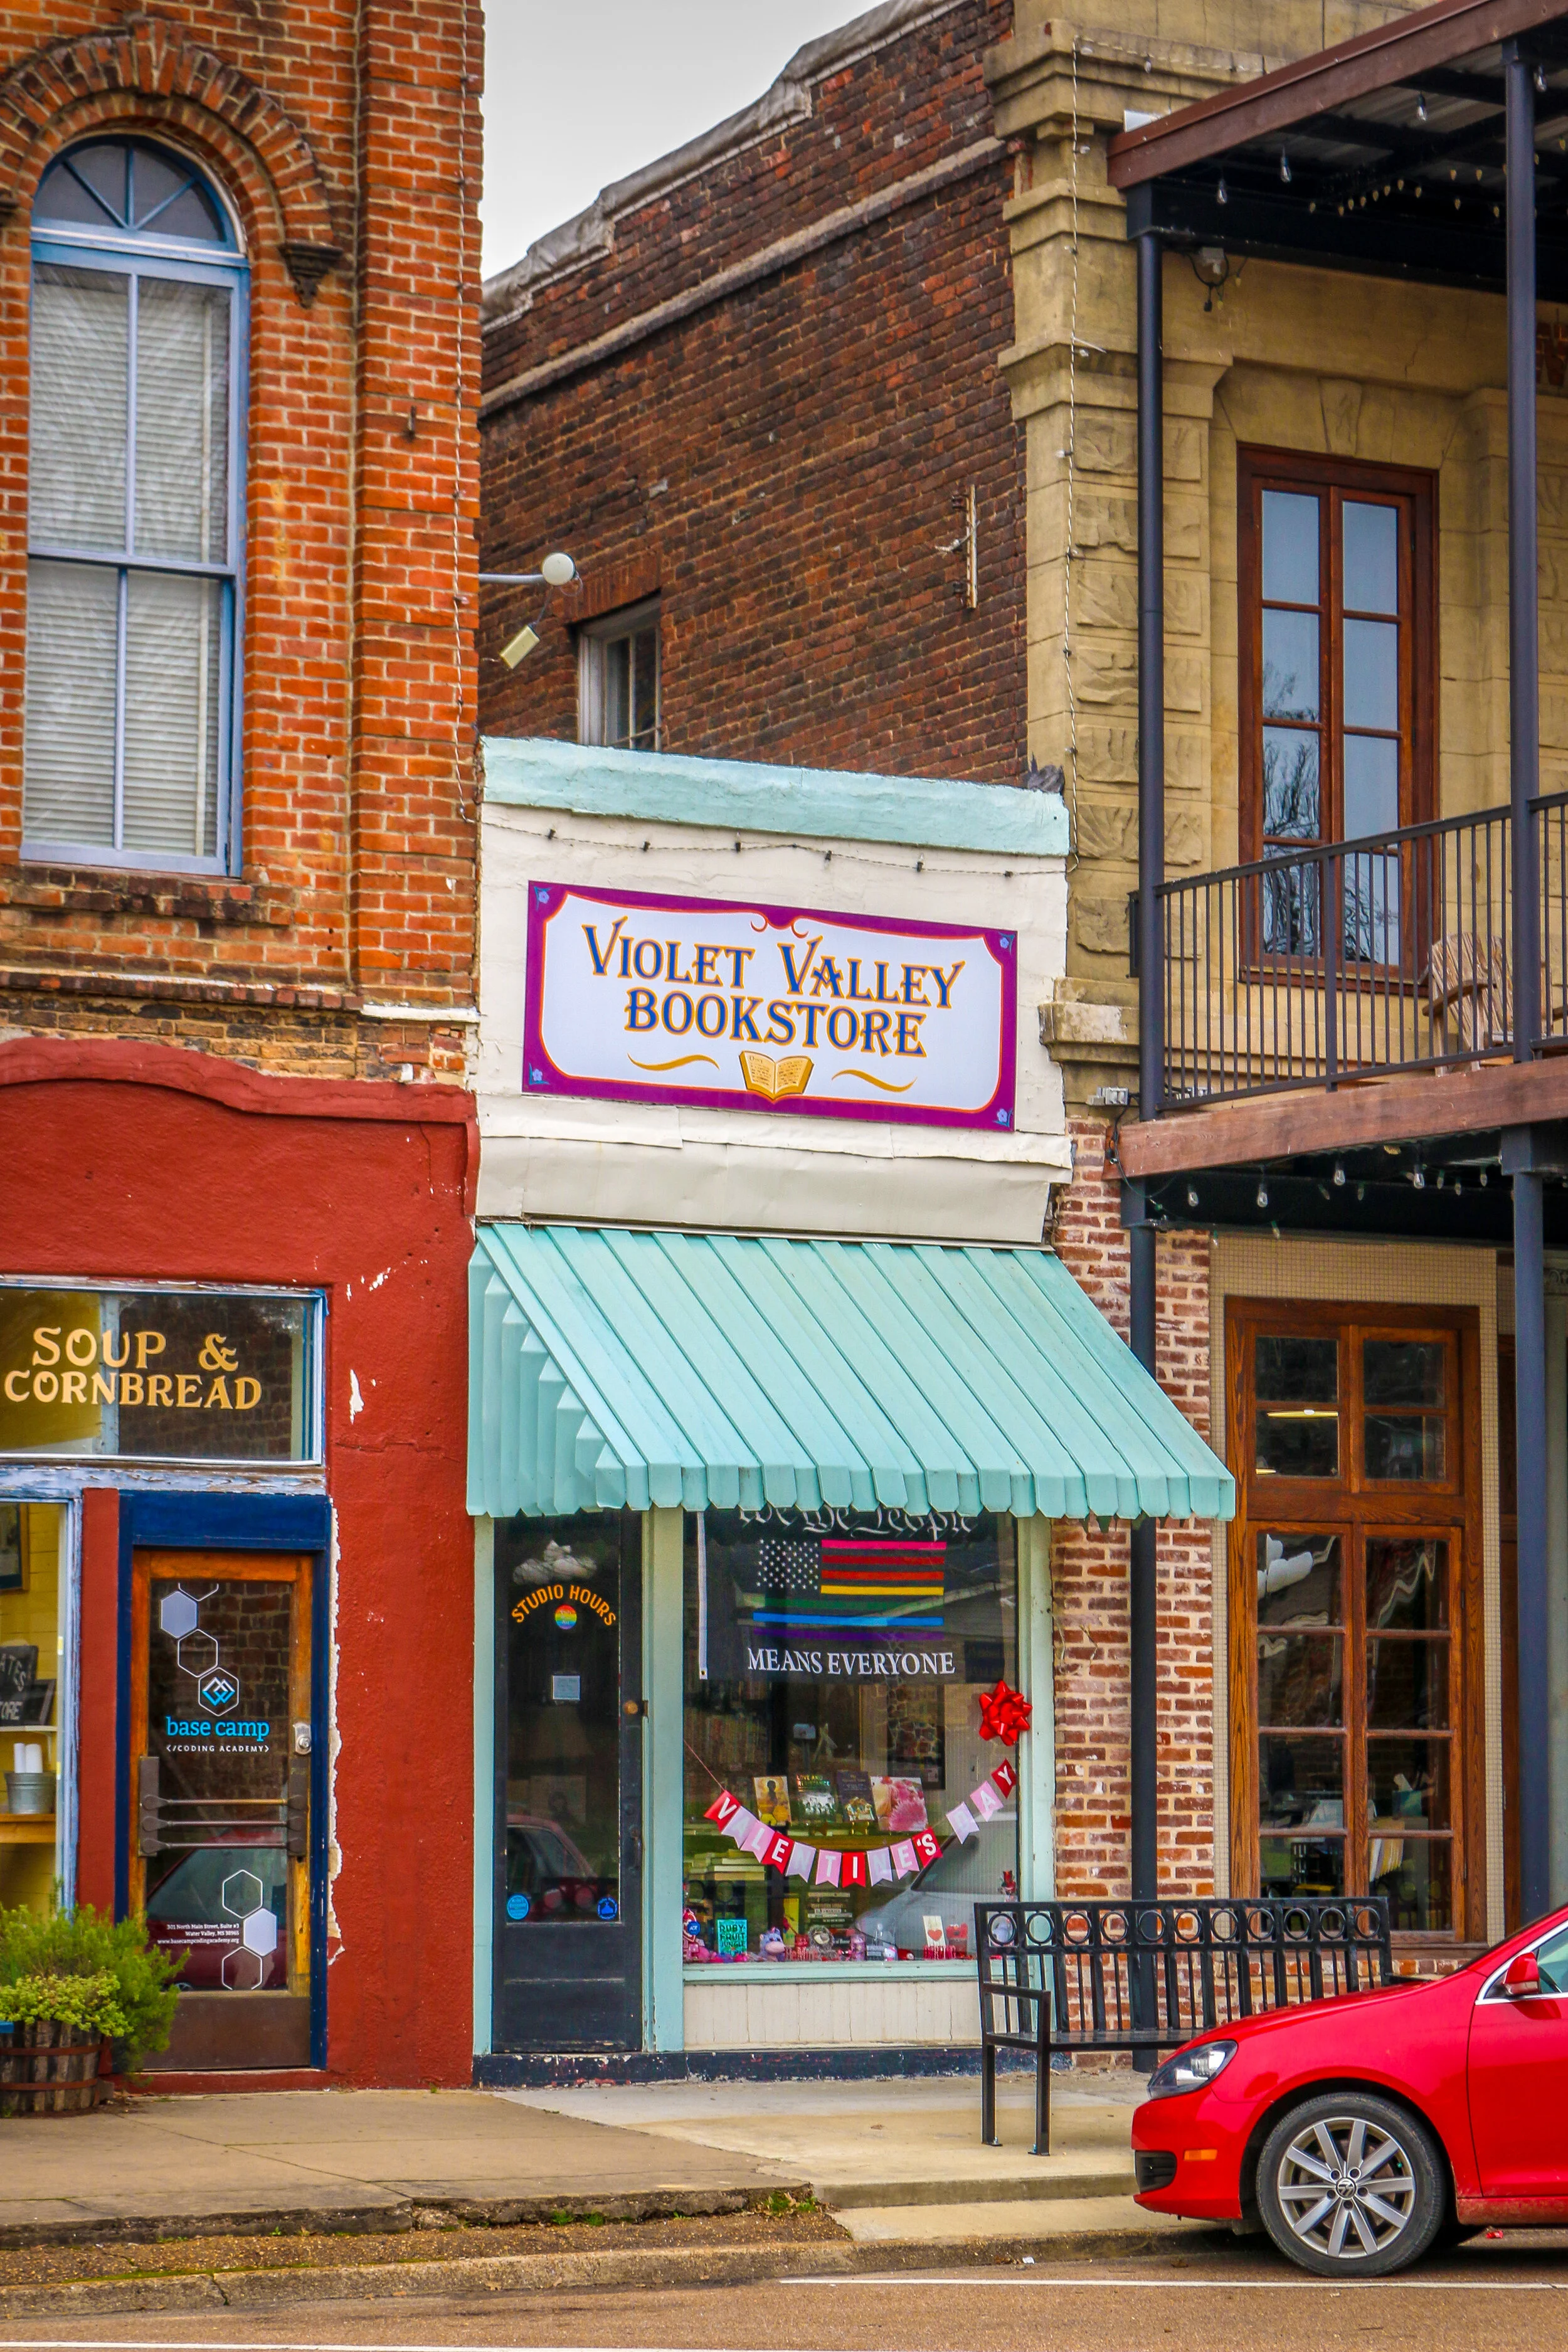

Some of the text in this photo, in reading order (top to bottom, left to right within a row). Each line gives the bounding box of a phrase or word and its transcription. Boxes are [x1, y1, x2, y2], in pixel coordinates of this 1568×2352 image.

[581, 916, 965, 1009] VIOLET VALLEY
[625, 987, 927, 1057] BOOKSTORE
[32, 1327, 239, 1372] SOUP &
[4, 1370, 262, 1410] CORNBREAD
[511, 1584, 616, 1626] STUDIO HOURS
[747, 1648, 823, 1674] MEANS
[828, 1651, 956, 1675] EVERYONE
[166, 1715, 270, 1742] base camp
[717, 1765, 1012, 1879] VALENTINE'S DAY
